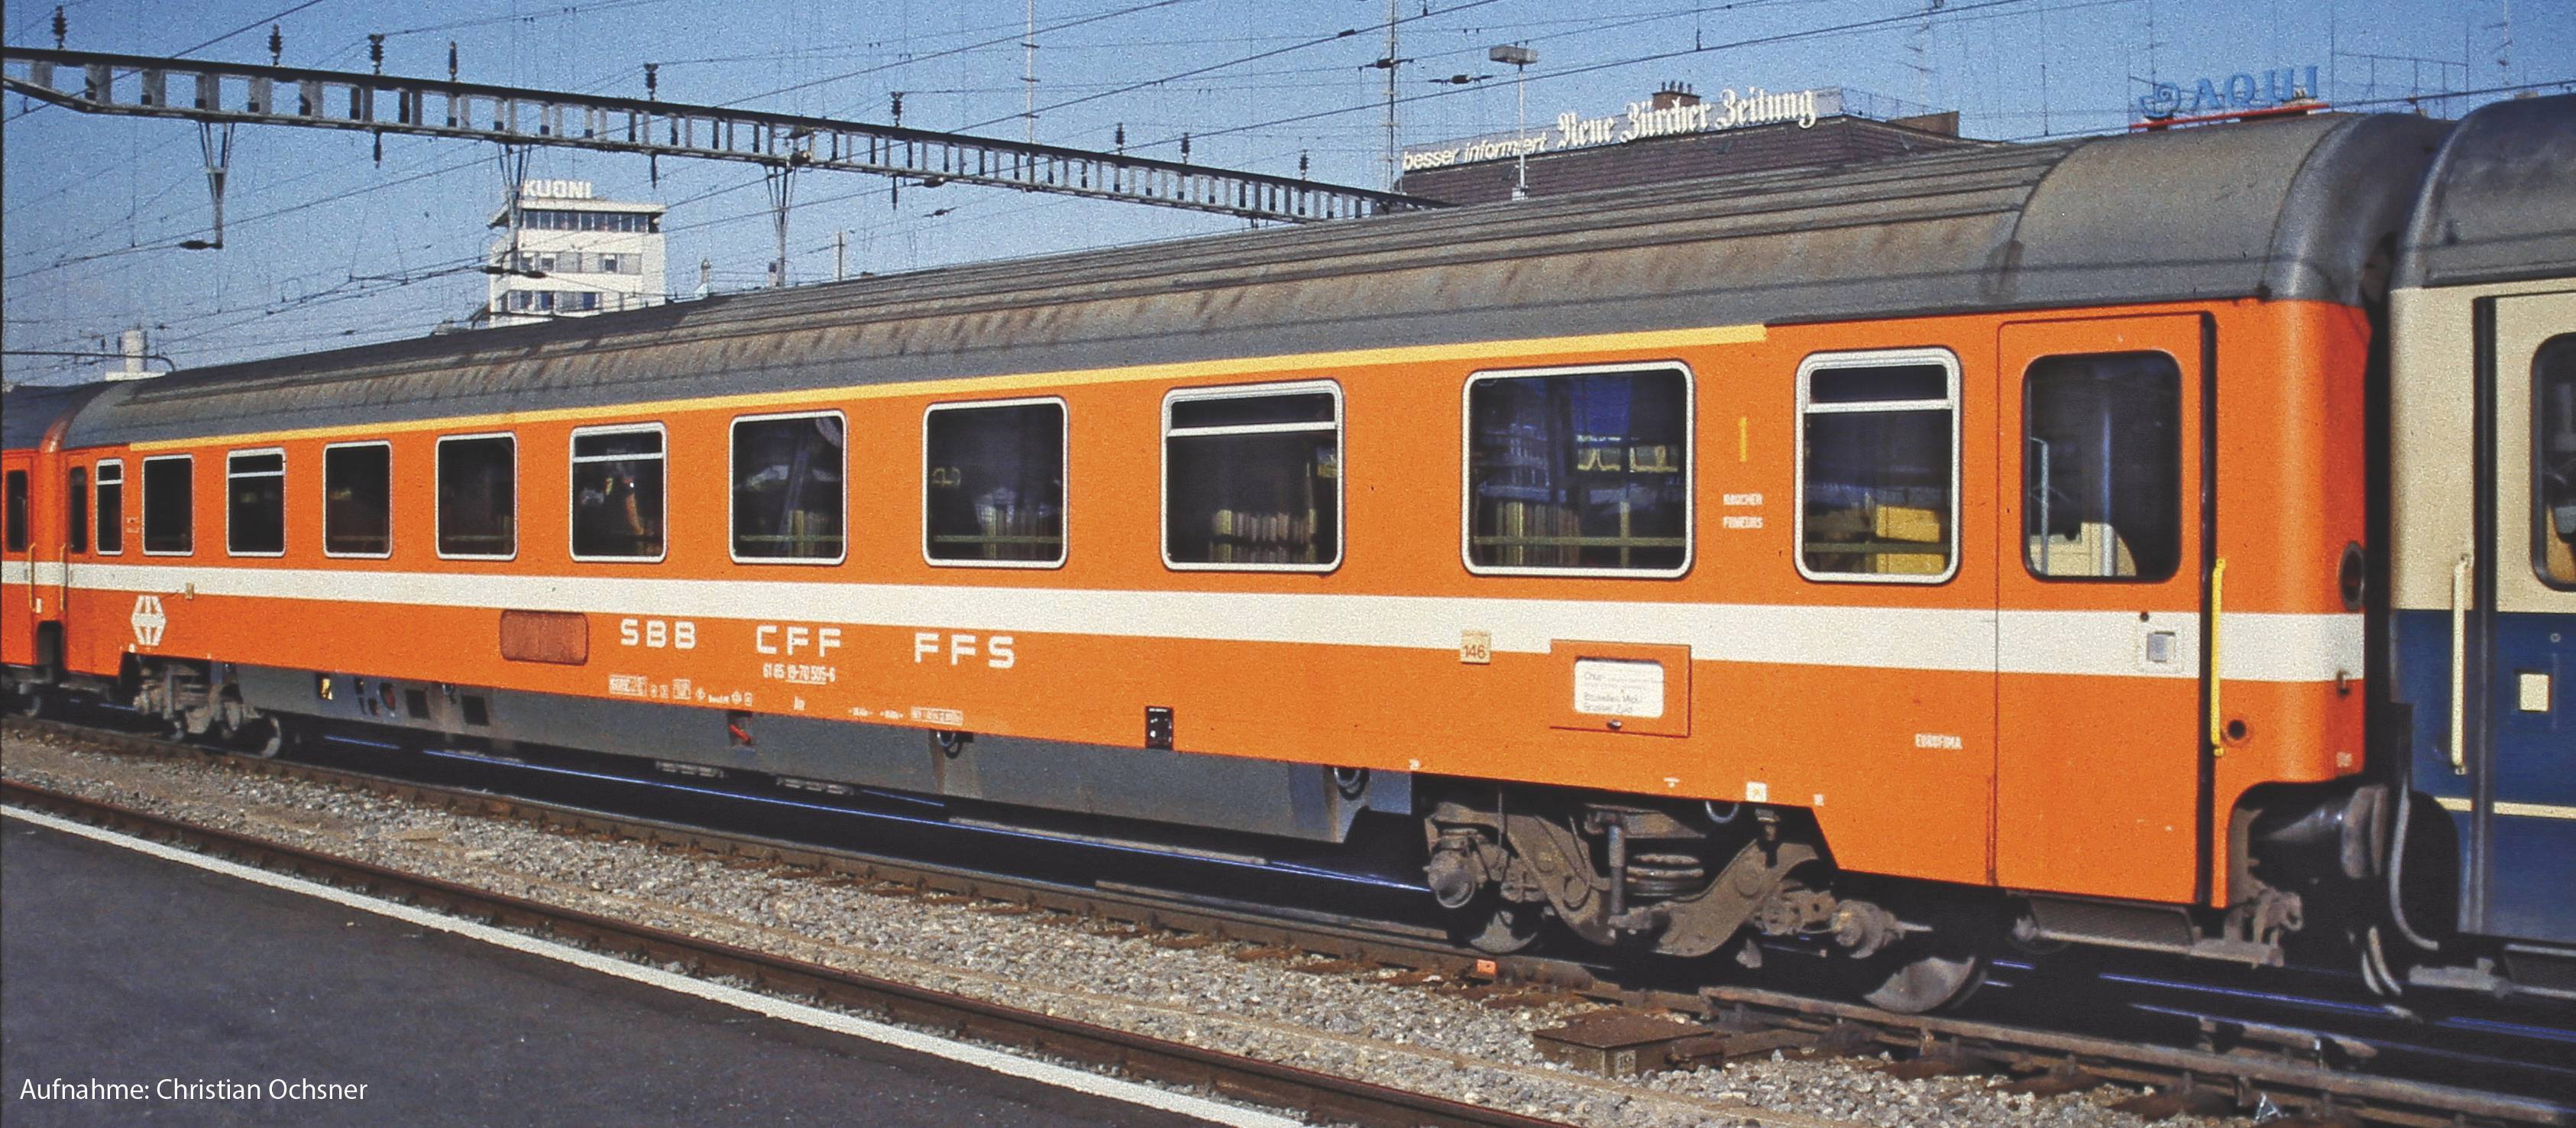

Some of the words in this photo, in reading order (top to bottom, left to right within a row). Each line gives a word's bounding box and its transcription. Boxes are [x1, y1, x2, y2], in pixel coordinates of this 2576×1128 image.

[1557, 112, 1614, 149] Neue
[1619, 96, 1711, 144] Zürcher
[1714, 86, 1817, 130] Zeitung
[1402, 148, 1460, 171] besser
[1464, 131, 1548, 164] informiert
[523, 179, 592, 199] KUONI
[620, 617, 697, 650] SBB
[756, 624, 842, 658] CFF
[914, 631, 1016, 669] FFS
[1463, 643, 1487, 660] 146
